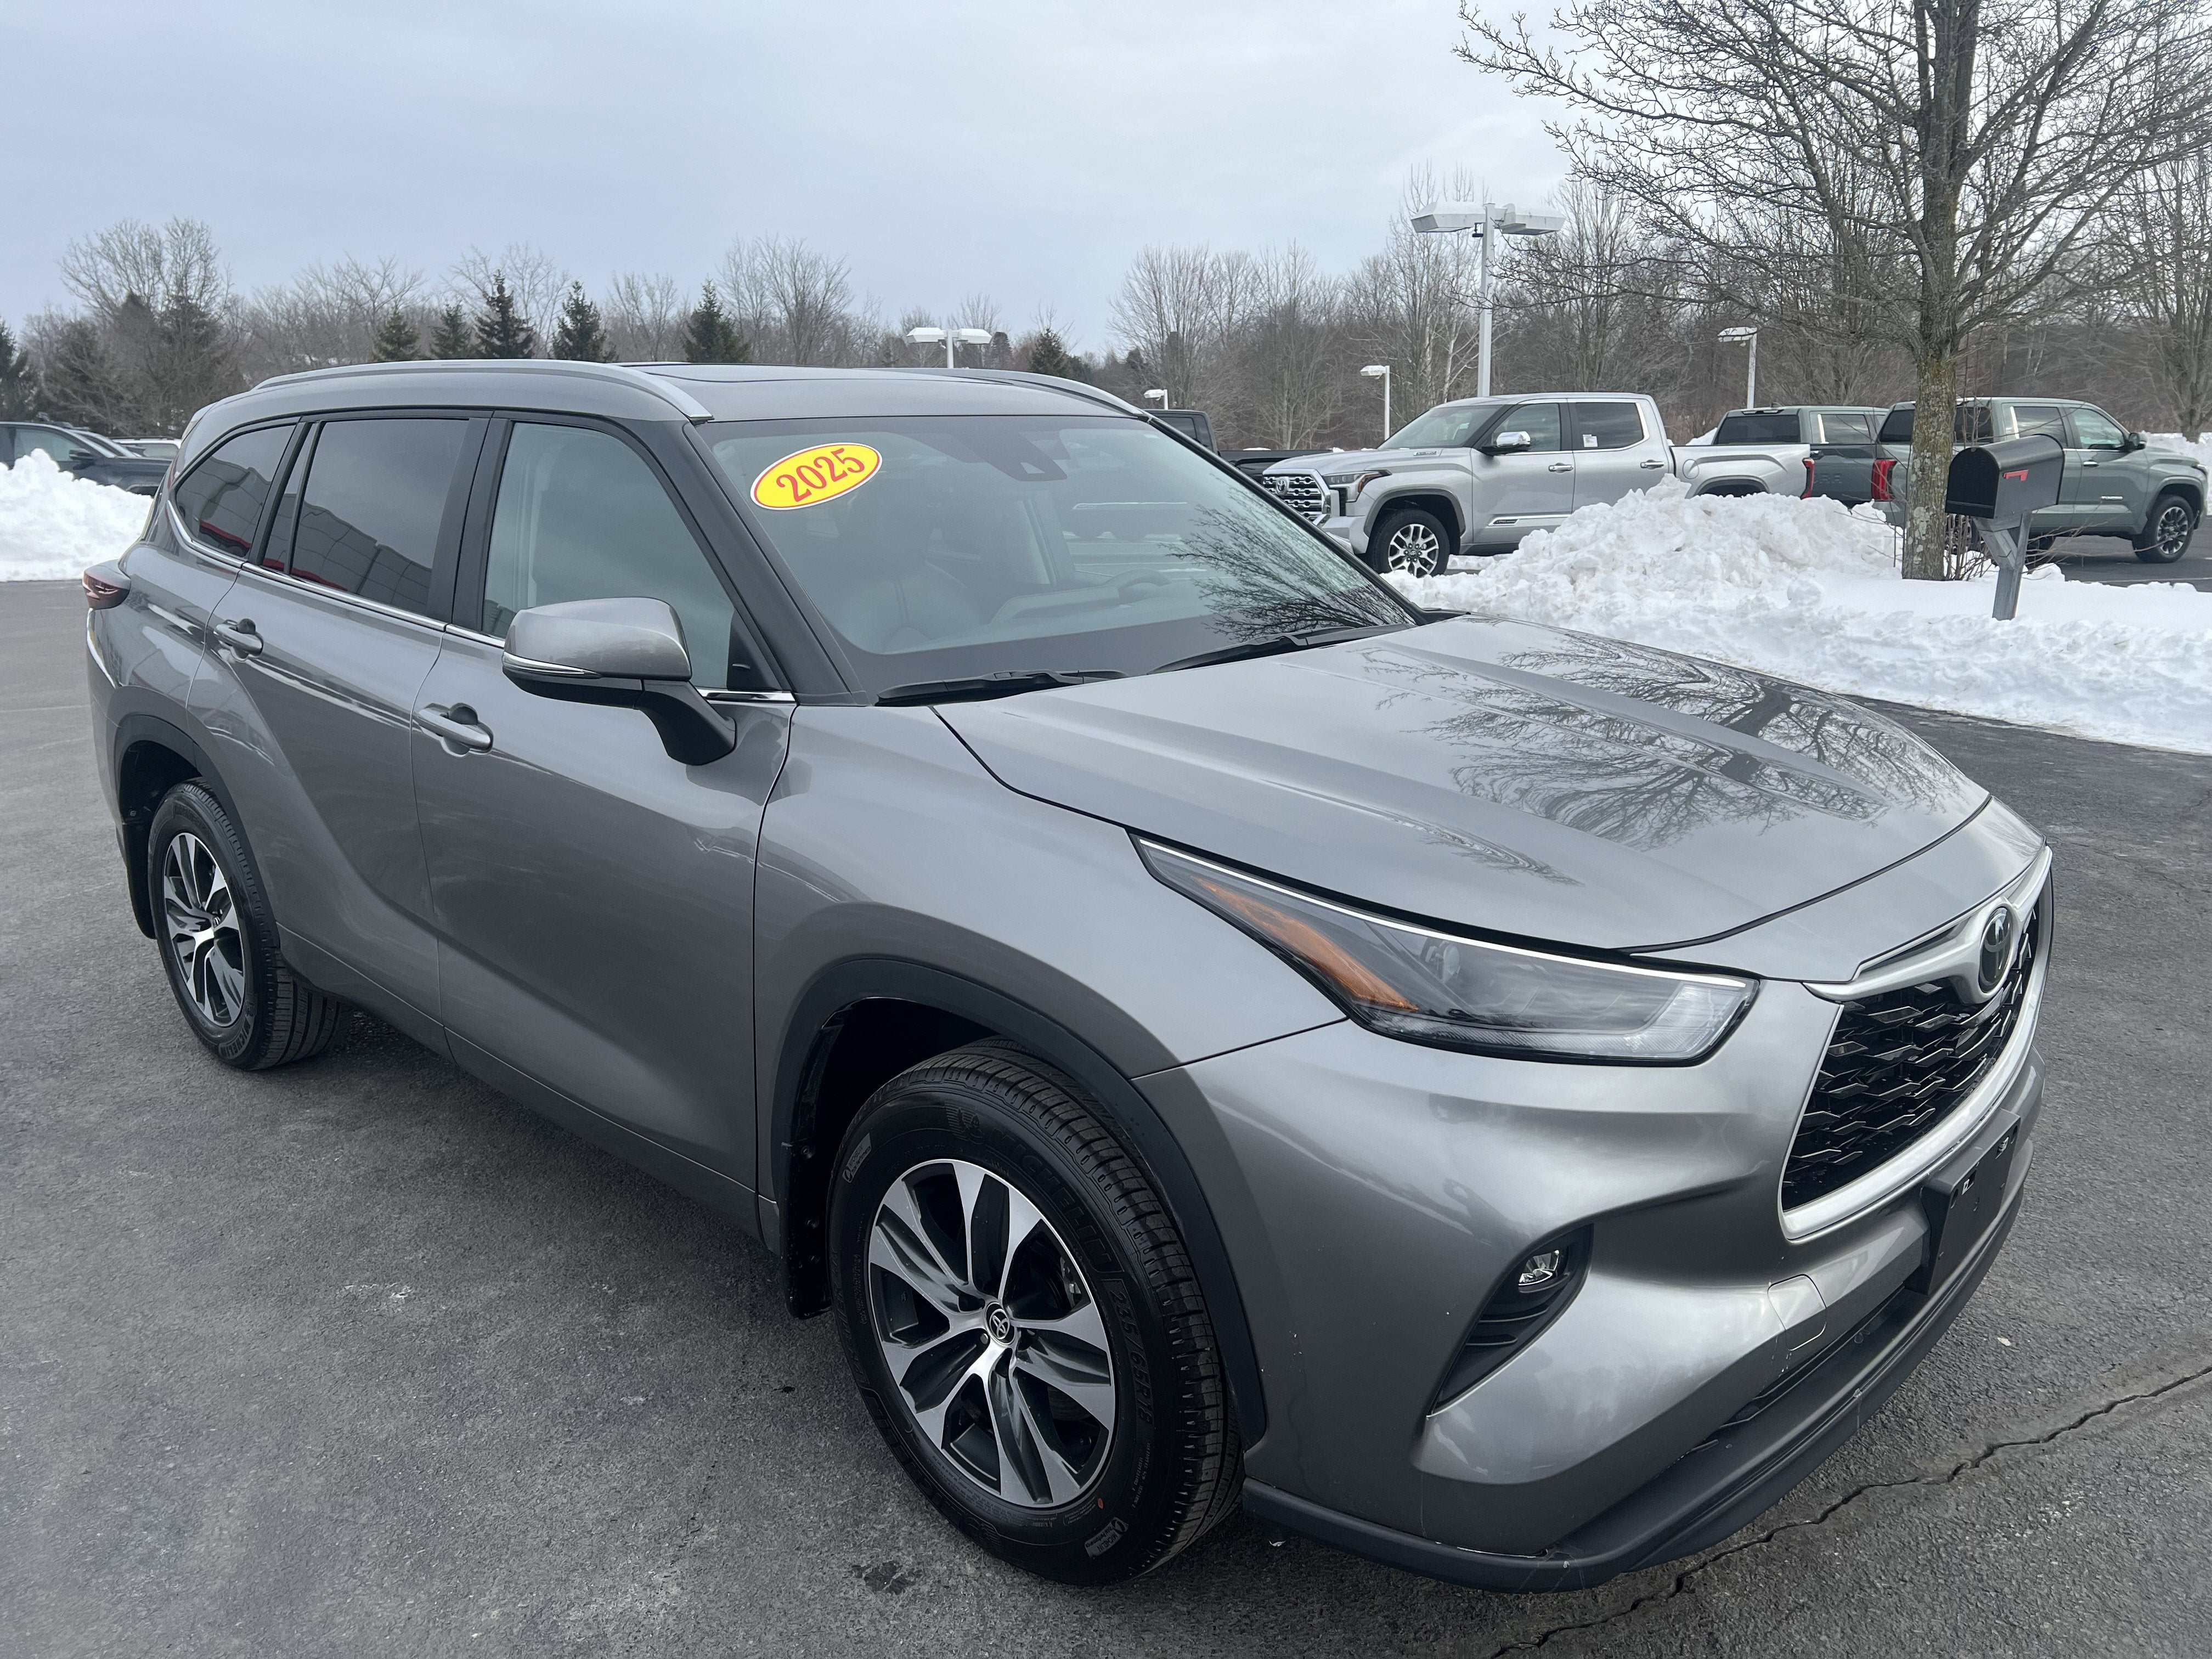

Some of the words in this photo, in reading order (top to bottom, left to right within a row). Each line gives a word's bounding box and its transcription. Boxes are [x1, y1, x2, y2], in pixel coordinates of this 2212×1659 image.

[776, 448, 865, 503] 2025
[989, 1128, 1113, 1268] MICHELIN
[1109, 1289, 1154, 1425] 235/65R18
